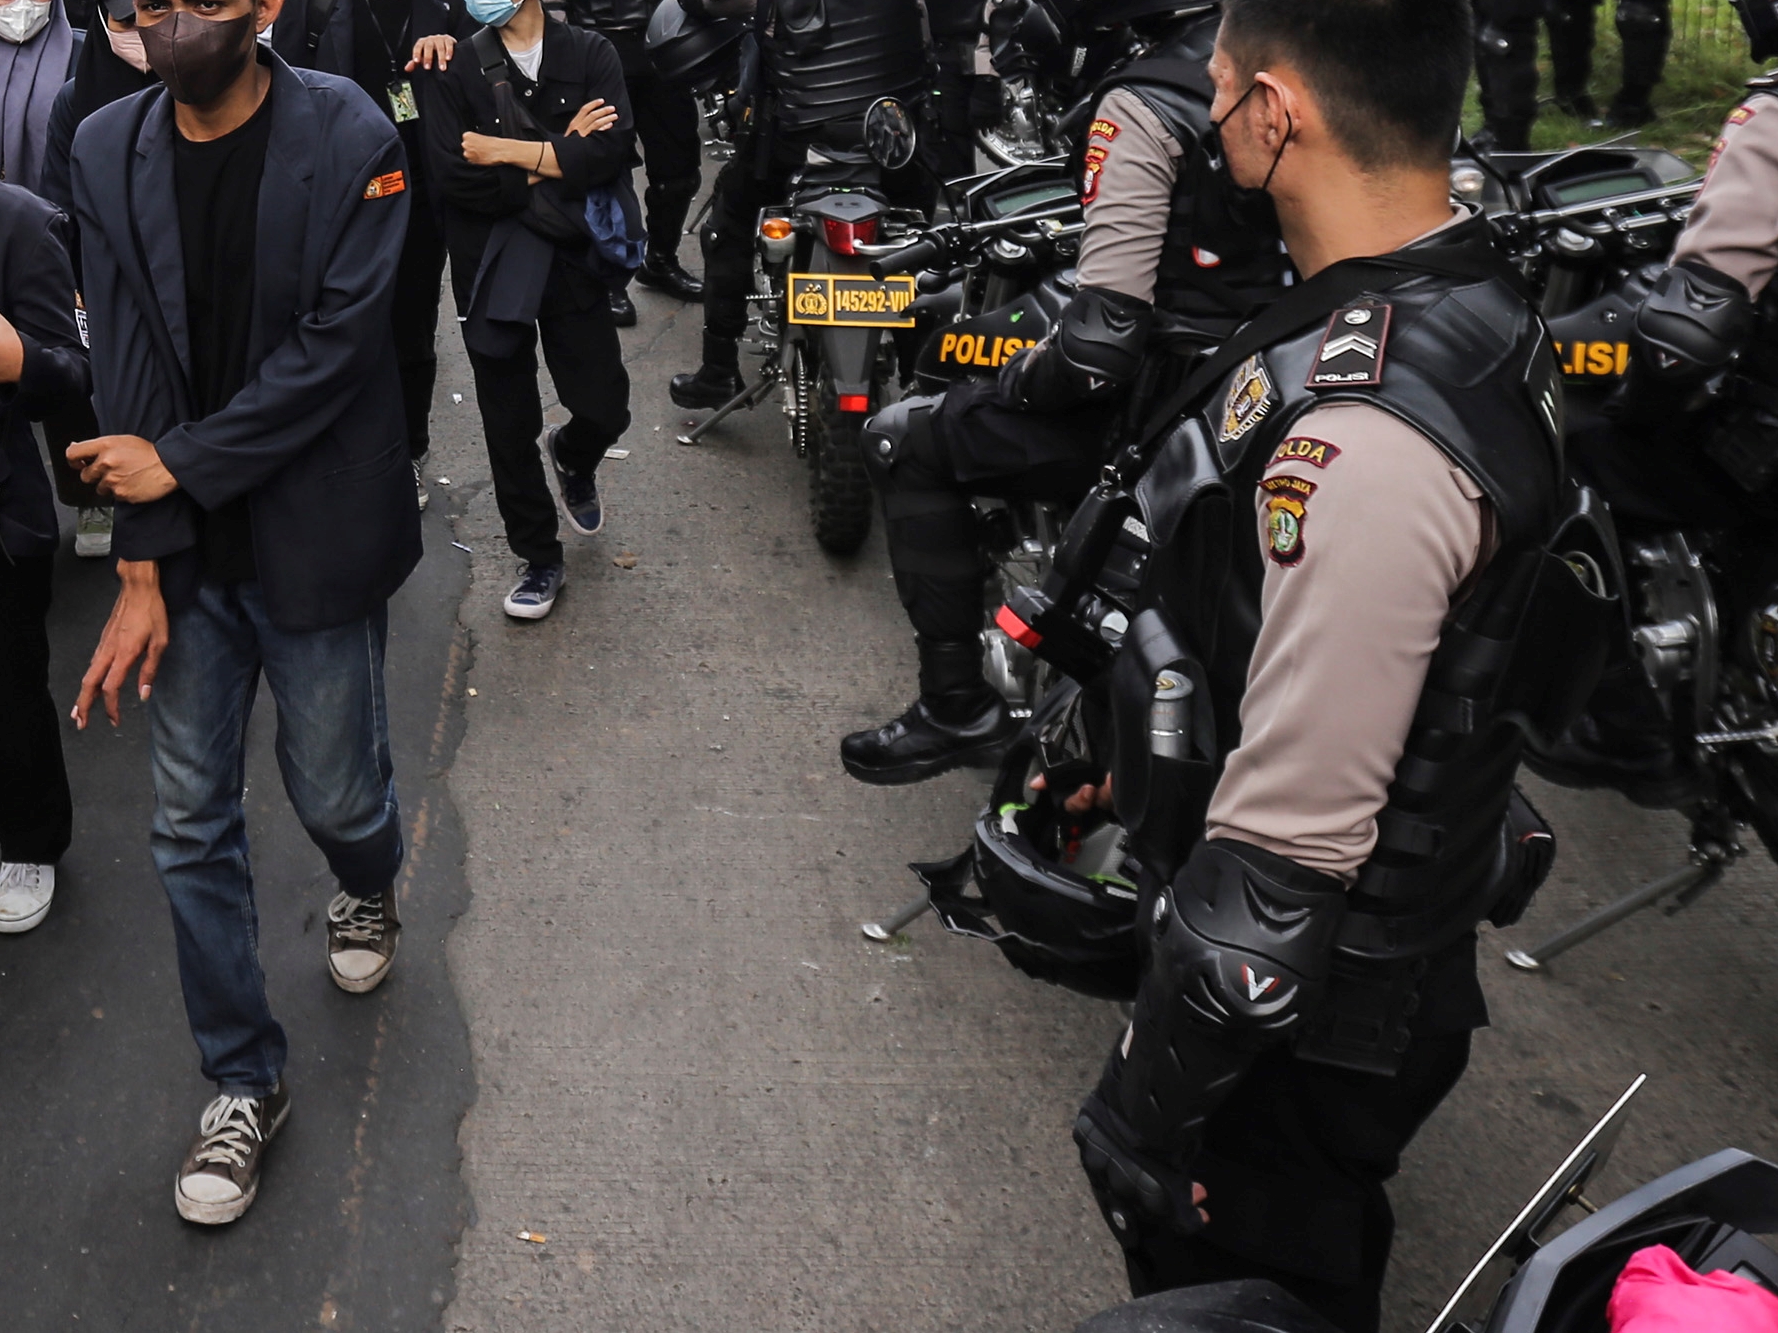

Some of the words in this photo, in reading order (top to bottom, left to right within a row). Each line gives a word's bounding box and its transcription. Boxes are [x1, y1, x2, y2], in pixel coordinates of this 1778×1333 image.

[1090, 122, 1115, 137] OLDA
[940, 334, 1036, 368] POLIS
[1314, 371, 1370, 383] POLISI
[1277, 440, 1327, 463] OLDA
